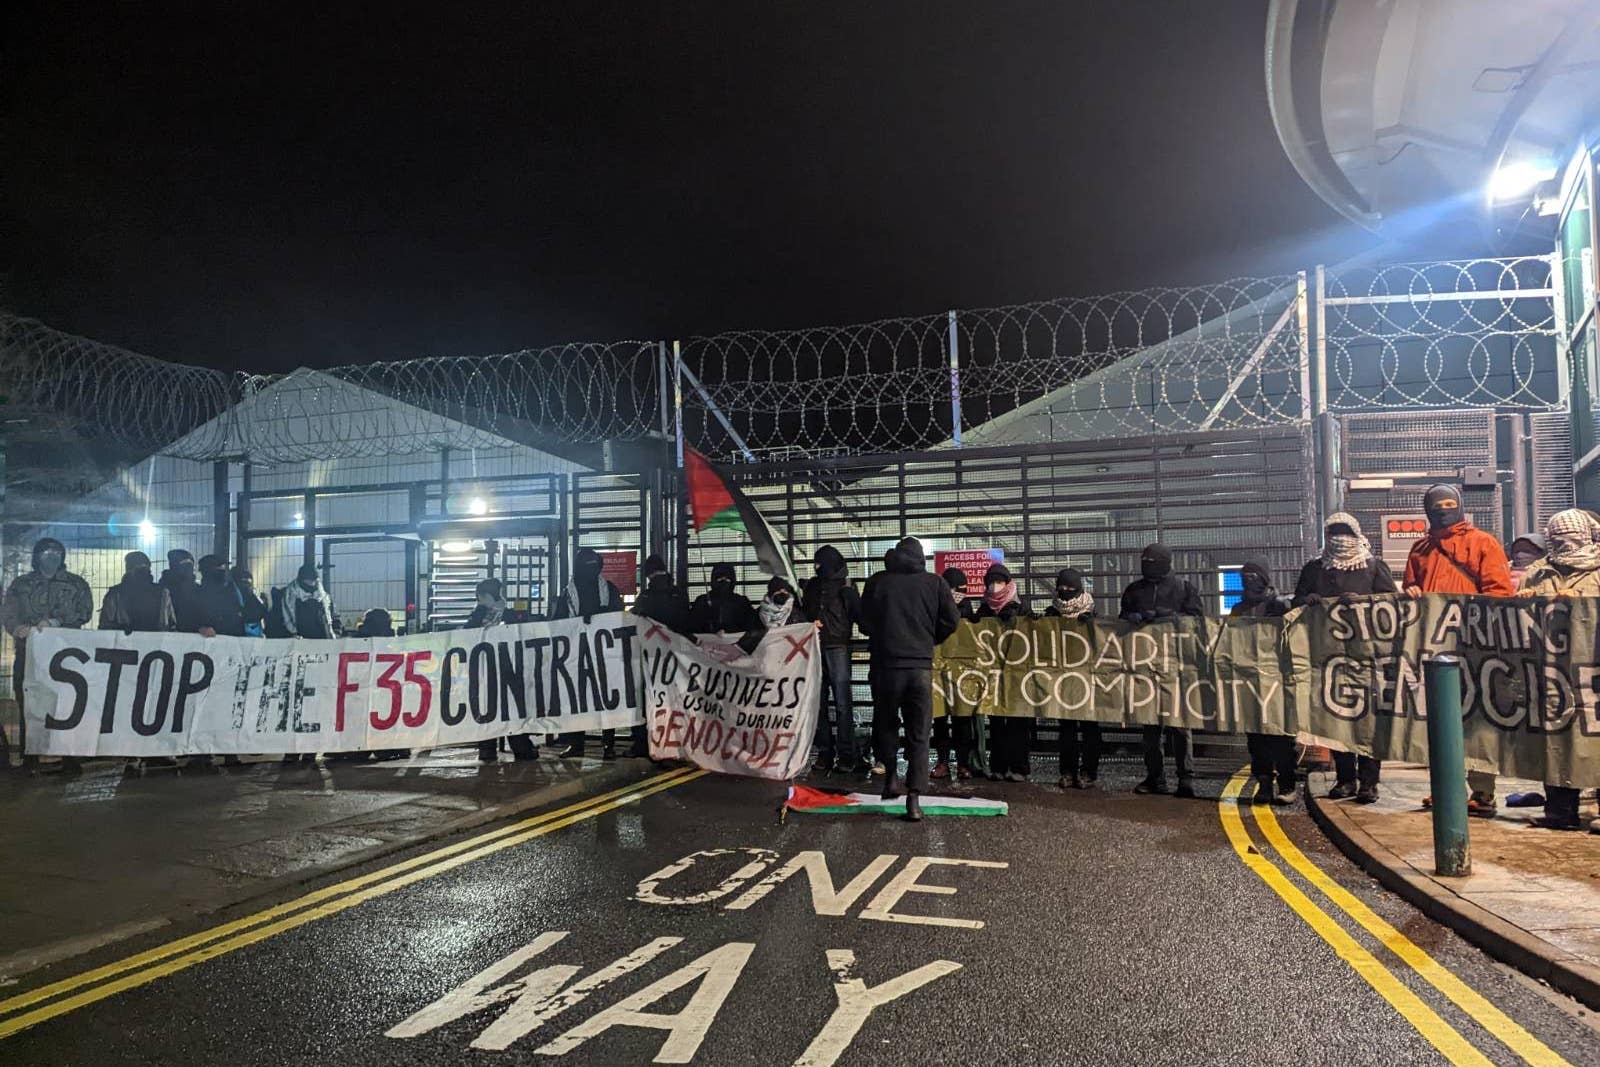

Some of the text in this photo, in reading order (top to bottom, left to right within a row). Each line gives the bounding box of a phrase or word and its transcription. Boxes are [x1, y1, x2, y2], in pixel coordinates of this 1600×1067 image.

[944, 553, 975, 561] ACCESS
[944, 561, 992, 569] EMERGENCY
[967, 585, 986, 593] TIME
[977, 629, 1219, 673] SOLIDARITY
[1328, 599, 1573, 655] STOP ARMING
[44, 625, 637, 736] STOP THE F35 CONTRACT
[687, 662, 805, 709] BUSINESS
[932, 669, 1279, 726] NOT COMPLICITY
[653, 691, 793, 729] S USUAL DURING
[651, 709, 796, 768] GENOCIDE
[633, 846, 1009, 928] ONE
[383, 931, 963, 1067] WAY
